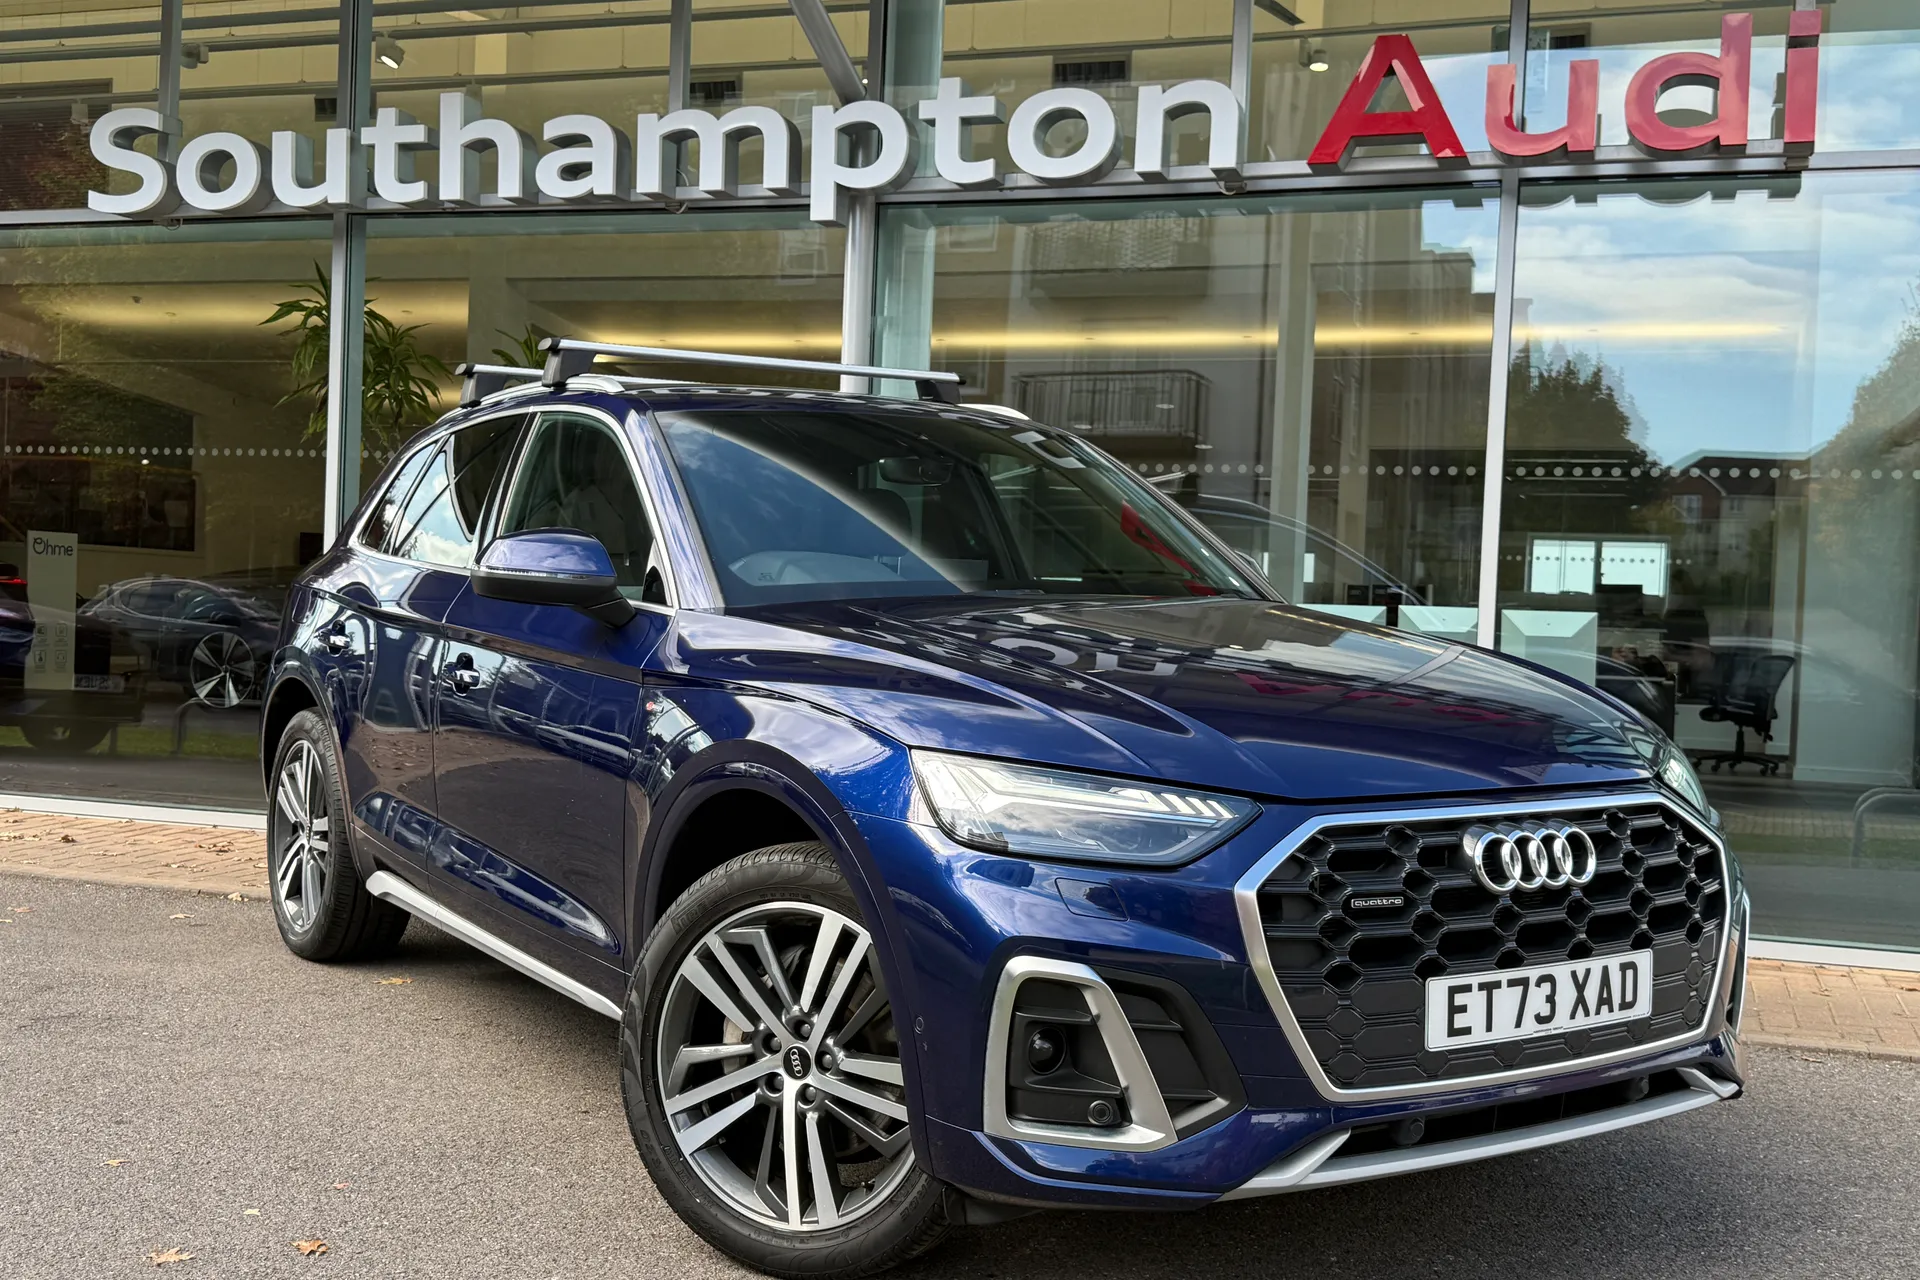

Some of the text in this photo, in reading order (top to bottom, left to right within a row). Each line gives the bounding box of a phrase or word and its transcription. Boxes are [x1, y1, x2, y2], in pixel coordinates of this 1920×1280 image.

[88, 10, 1821, 220] Southampton Audi
[33, 537, 73, 556] Ohme
[1354, 898, 1402, 907] quattro
[1447, 961, 1638, 1037] ET73 XAD
